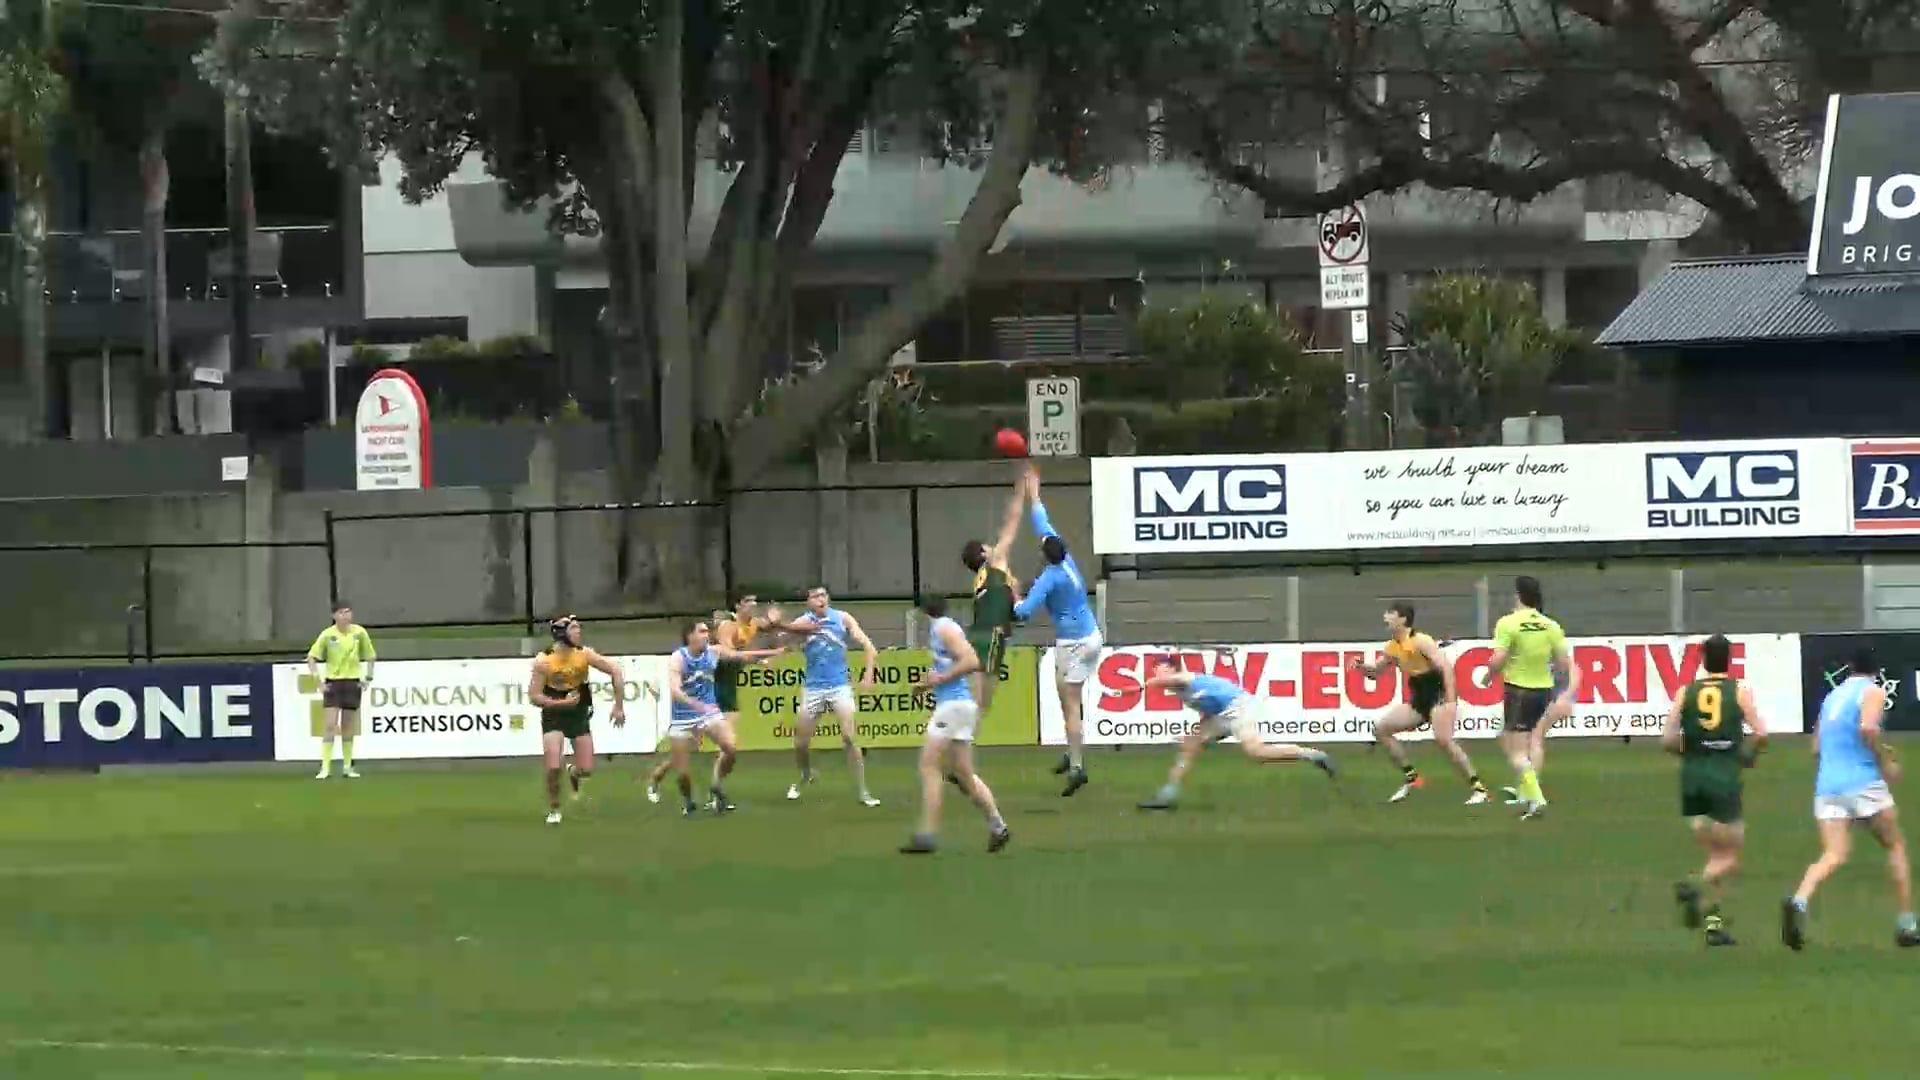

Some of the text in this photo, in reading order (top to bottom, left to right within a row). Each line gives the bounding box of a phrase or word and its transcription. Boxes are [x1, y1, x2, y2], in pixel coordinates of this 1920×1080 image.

[1036, 383, 1068, 395] END
[1043, 401, 1064, 427] P
[1035, 432, 1070, 440] TICKET
[1040, 443, 1068, 452] AREA
[1363, 466, 1390, 480] we
[1464, 460, 1511, 485] your
[1516, 454, 1569, 475] dream
[1651, 455, 1795, 500] MC
[1139, 468, 1282, 513] MC
[1366, 499, 1380, 513] so
[1387, 498, 1424, 520] you
[1429, 494, 1455, 508] can
[1492, 495, 1508, 506] in
[1514, 488, 1568, 517] luxury
[1647, 507, 1800, 527] BUILDING
[1135, 520, 1288, 541] BUILDING
[370, 685, 487, 707] DUNCAN
[759, 696, 784, 714] OF
[858, 692, 937, 712] EXTENS
[1697, 686, 1722, 731] 9
[371, 713, 503, 733] EXTENSIONS
[1097, 717, 1200, 738] Complete
[1584, 712, 1622, 731] any
